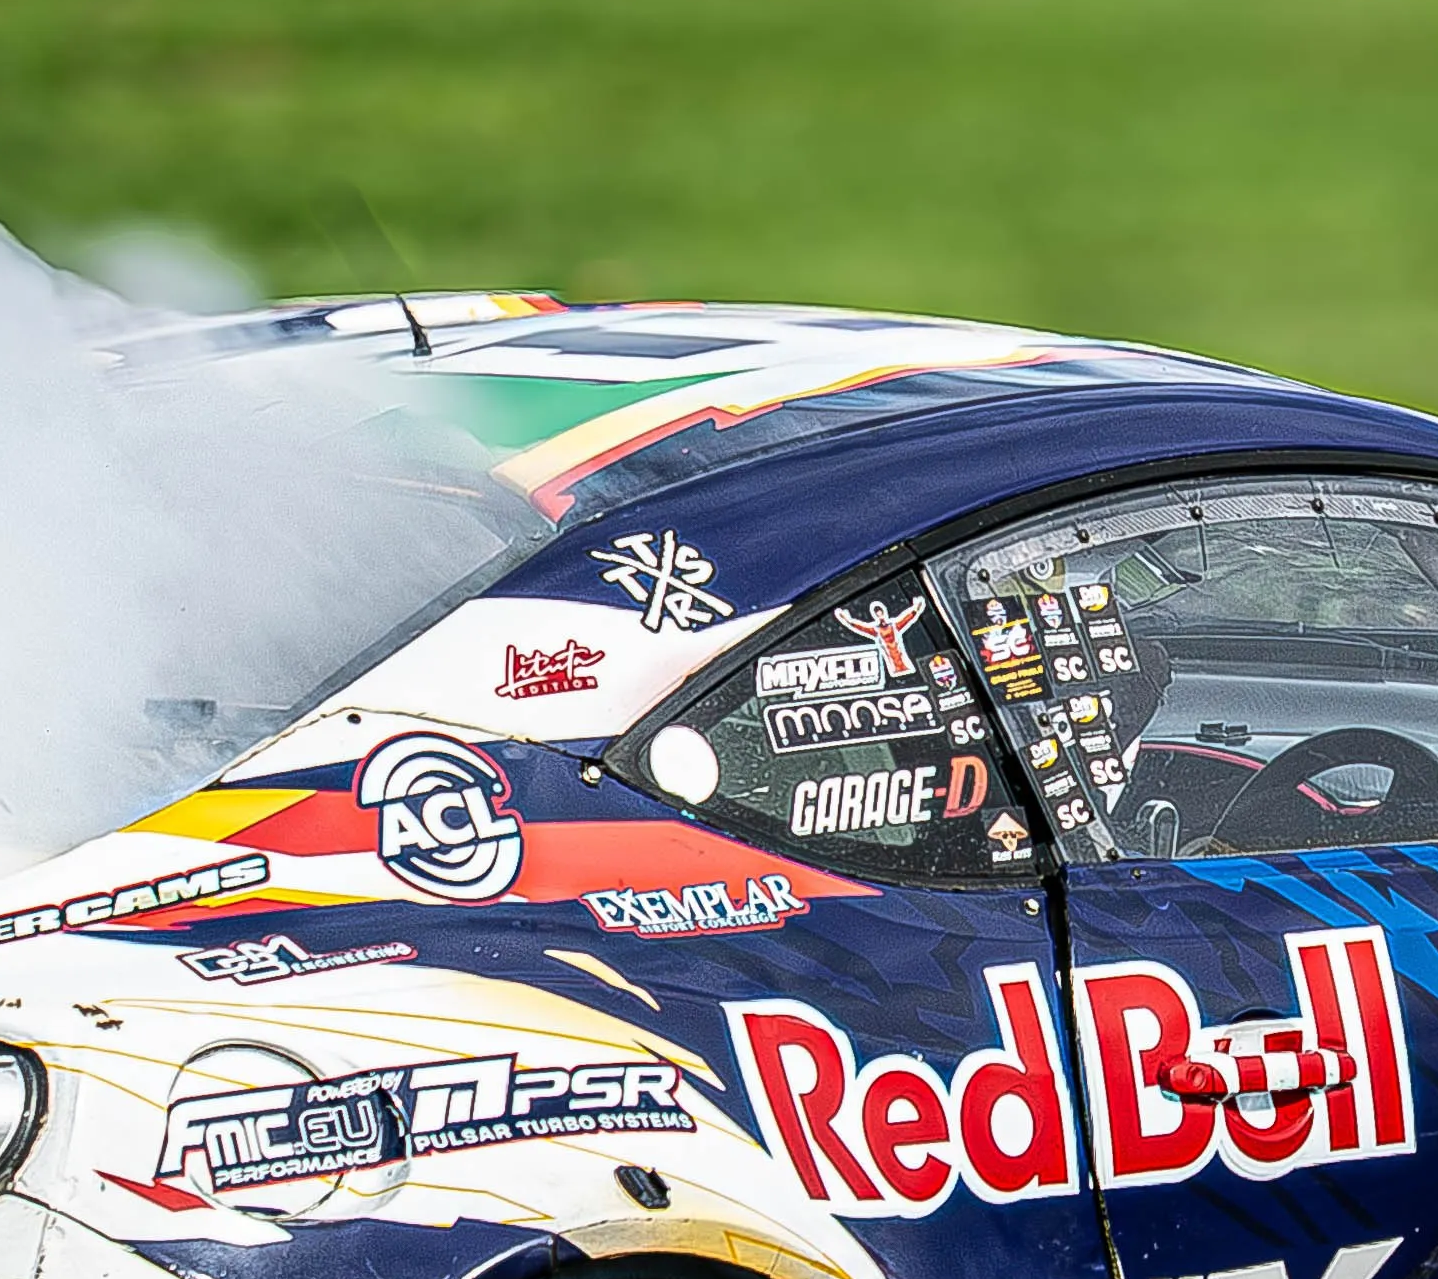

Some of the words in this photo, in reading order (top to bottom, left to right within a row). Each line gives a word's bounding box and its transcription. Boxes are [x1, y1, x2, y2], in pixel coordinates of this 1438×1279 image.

[762, 652, 879, 691] MAXFLO
[1053, 655, 1088, 682] SC
[1098, 646, 1133, 673] SC
[517, 678, 596, 697] EDITION
[950, 715, 986, 745] SC
[1089, 757, 1124, 785] SC
[791, 754, 988, 837] GARAGE-D
[1056, 798, 1090, 830] SC
[382, 786, 519, 858] ACL
[65, 856, 270, 926] CAMS
[581, 874, 806, 928] EXEMPLAR
[637, 919, 697, 934] AIRPORT
[697, 912, 779, 931] CONCIERGE
[291, 942, 414, 973] ENGINEERING
[512, 1066, 678, 1116] PSR
[734, 970, 1074, 1210] Red
[1079, 934, 1410, 1180] Bull
[414, 1123, 513, 1152] PULSAR
[515, 1115, 598, 1137] TURBO
[598, 1111, 693, 1130] SYSTEMS
[215, 1146, 383, 1187] PERFORMANCE
